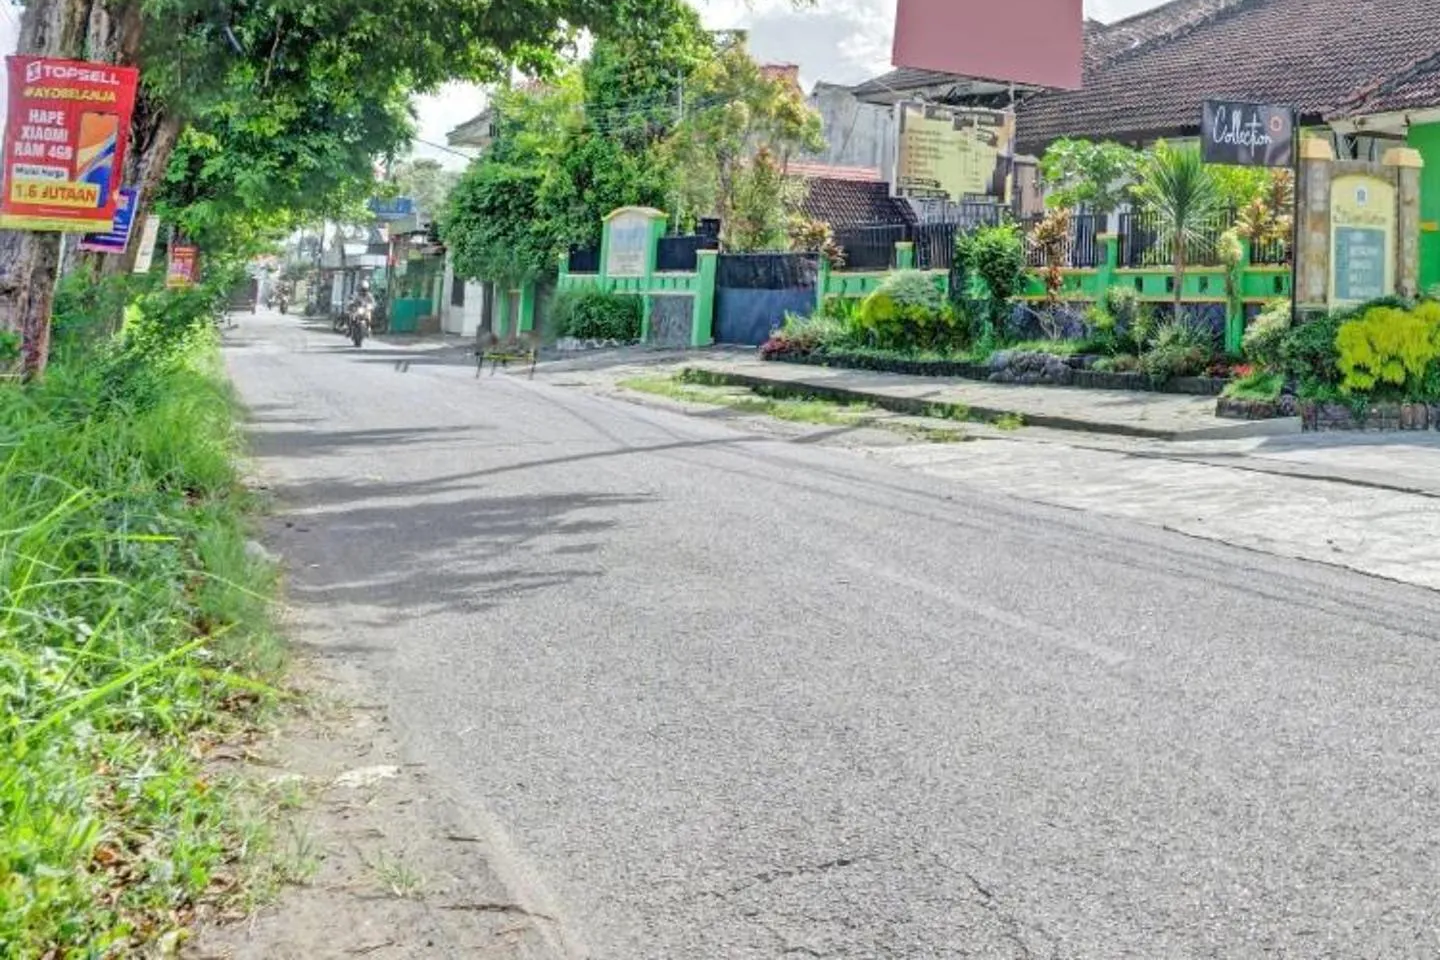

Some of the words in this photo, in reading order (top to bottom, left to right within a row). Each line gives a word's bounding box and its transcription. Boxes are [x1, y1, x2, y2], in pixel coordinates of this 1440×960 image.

[43, 65, 121, 86] TOPSELL
[28, 108, 65, 126] HAPE
[21, 125, 69, 142] XIAOMI
[1213, 105, 1272, 157] Collection
[14, 141, 46, 158] RAM
[47, 144, 74, 161] 4GB
[41, 185, 98, 203] JUTAAN
